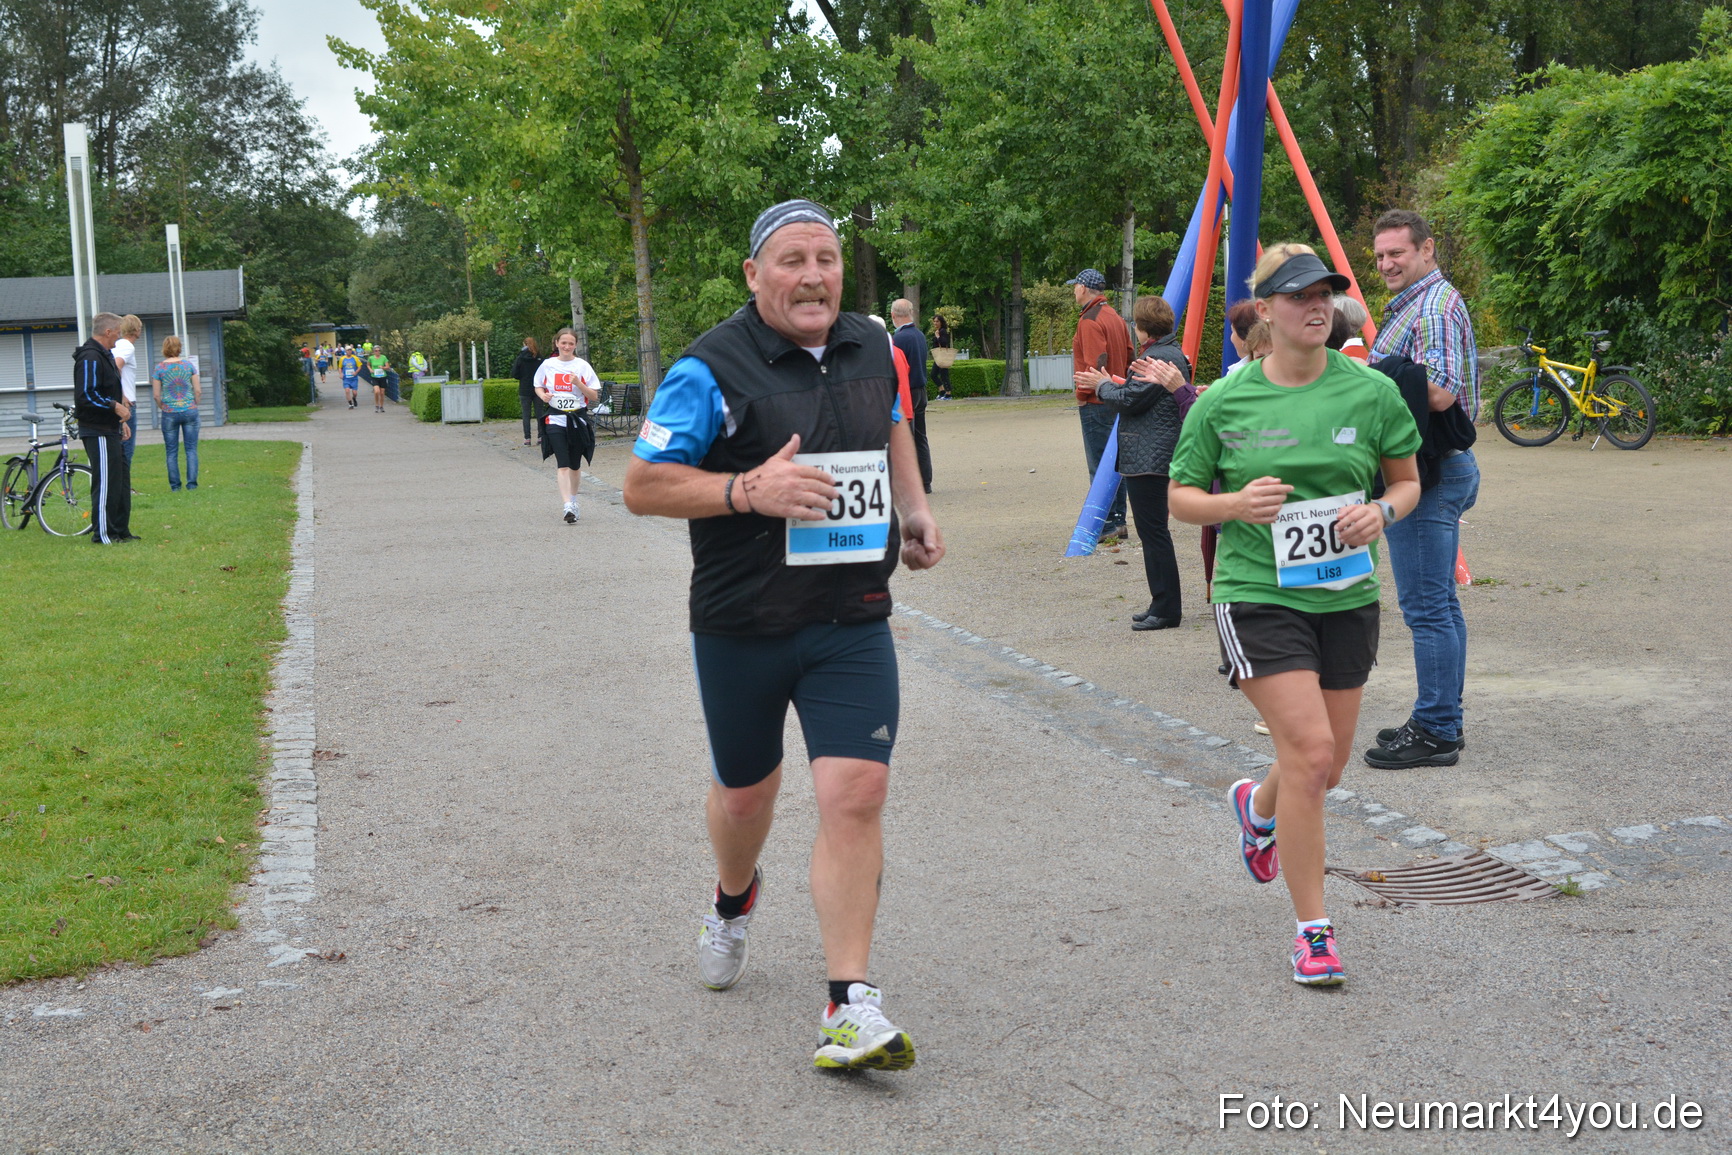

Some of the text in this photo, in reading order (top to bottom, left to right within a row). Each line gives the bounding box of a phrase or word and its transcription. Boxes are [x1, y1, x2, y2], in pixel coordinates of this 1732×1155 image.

[557, 400, 575, 409] 322
[831, 463, 876, 474] Neumarkt
[805, 479, 885, 521] 534
[828, 531, 864, 548] Hans
[1285, 519, 1358, 562] 230
[1316, 565, 1342, 581] Lisa
